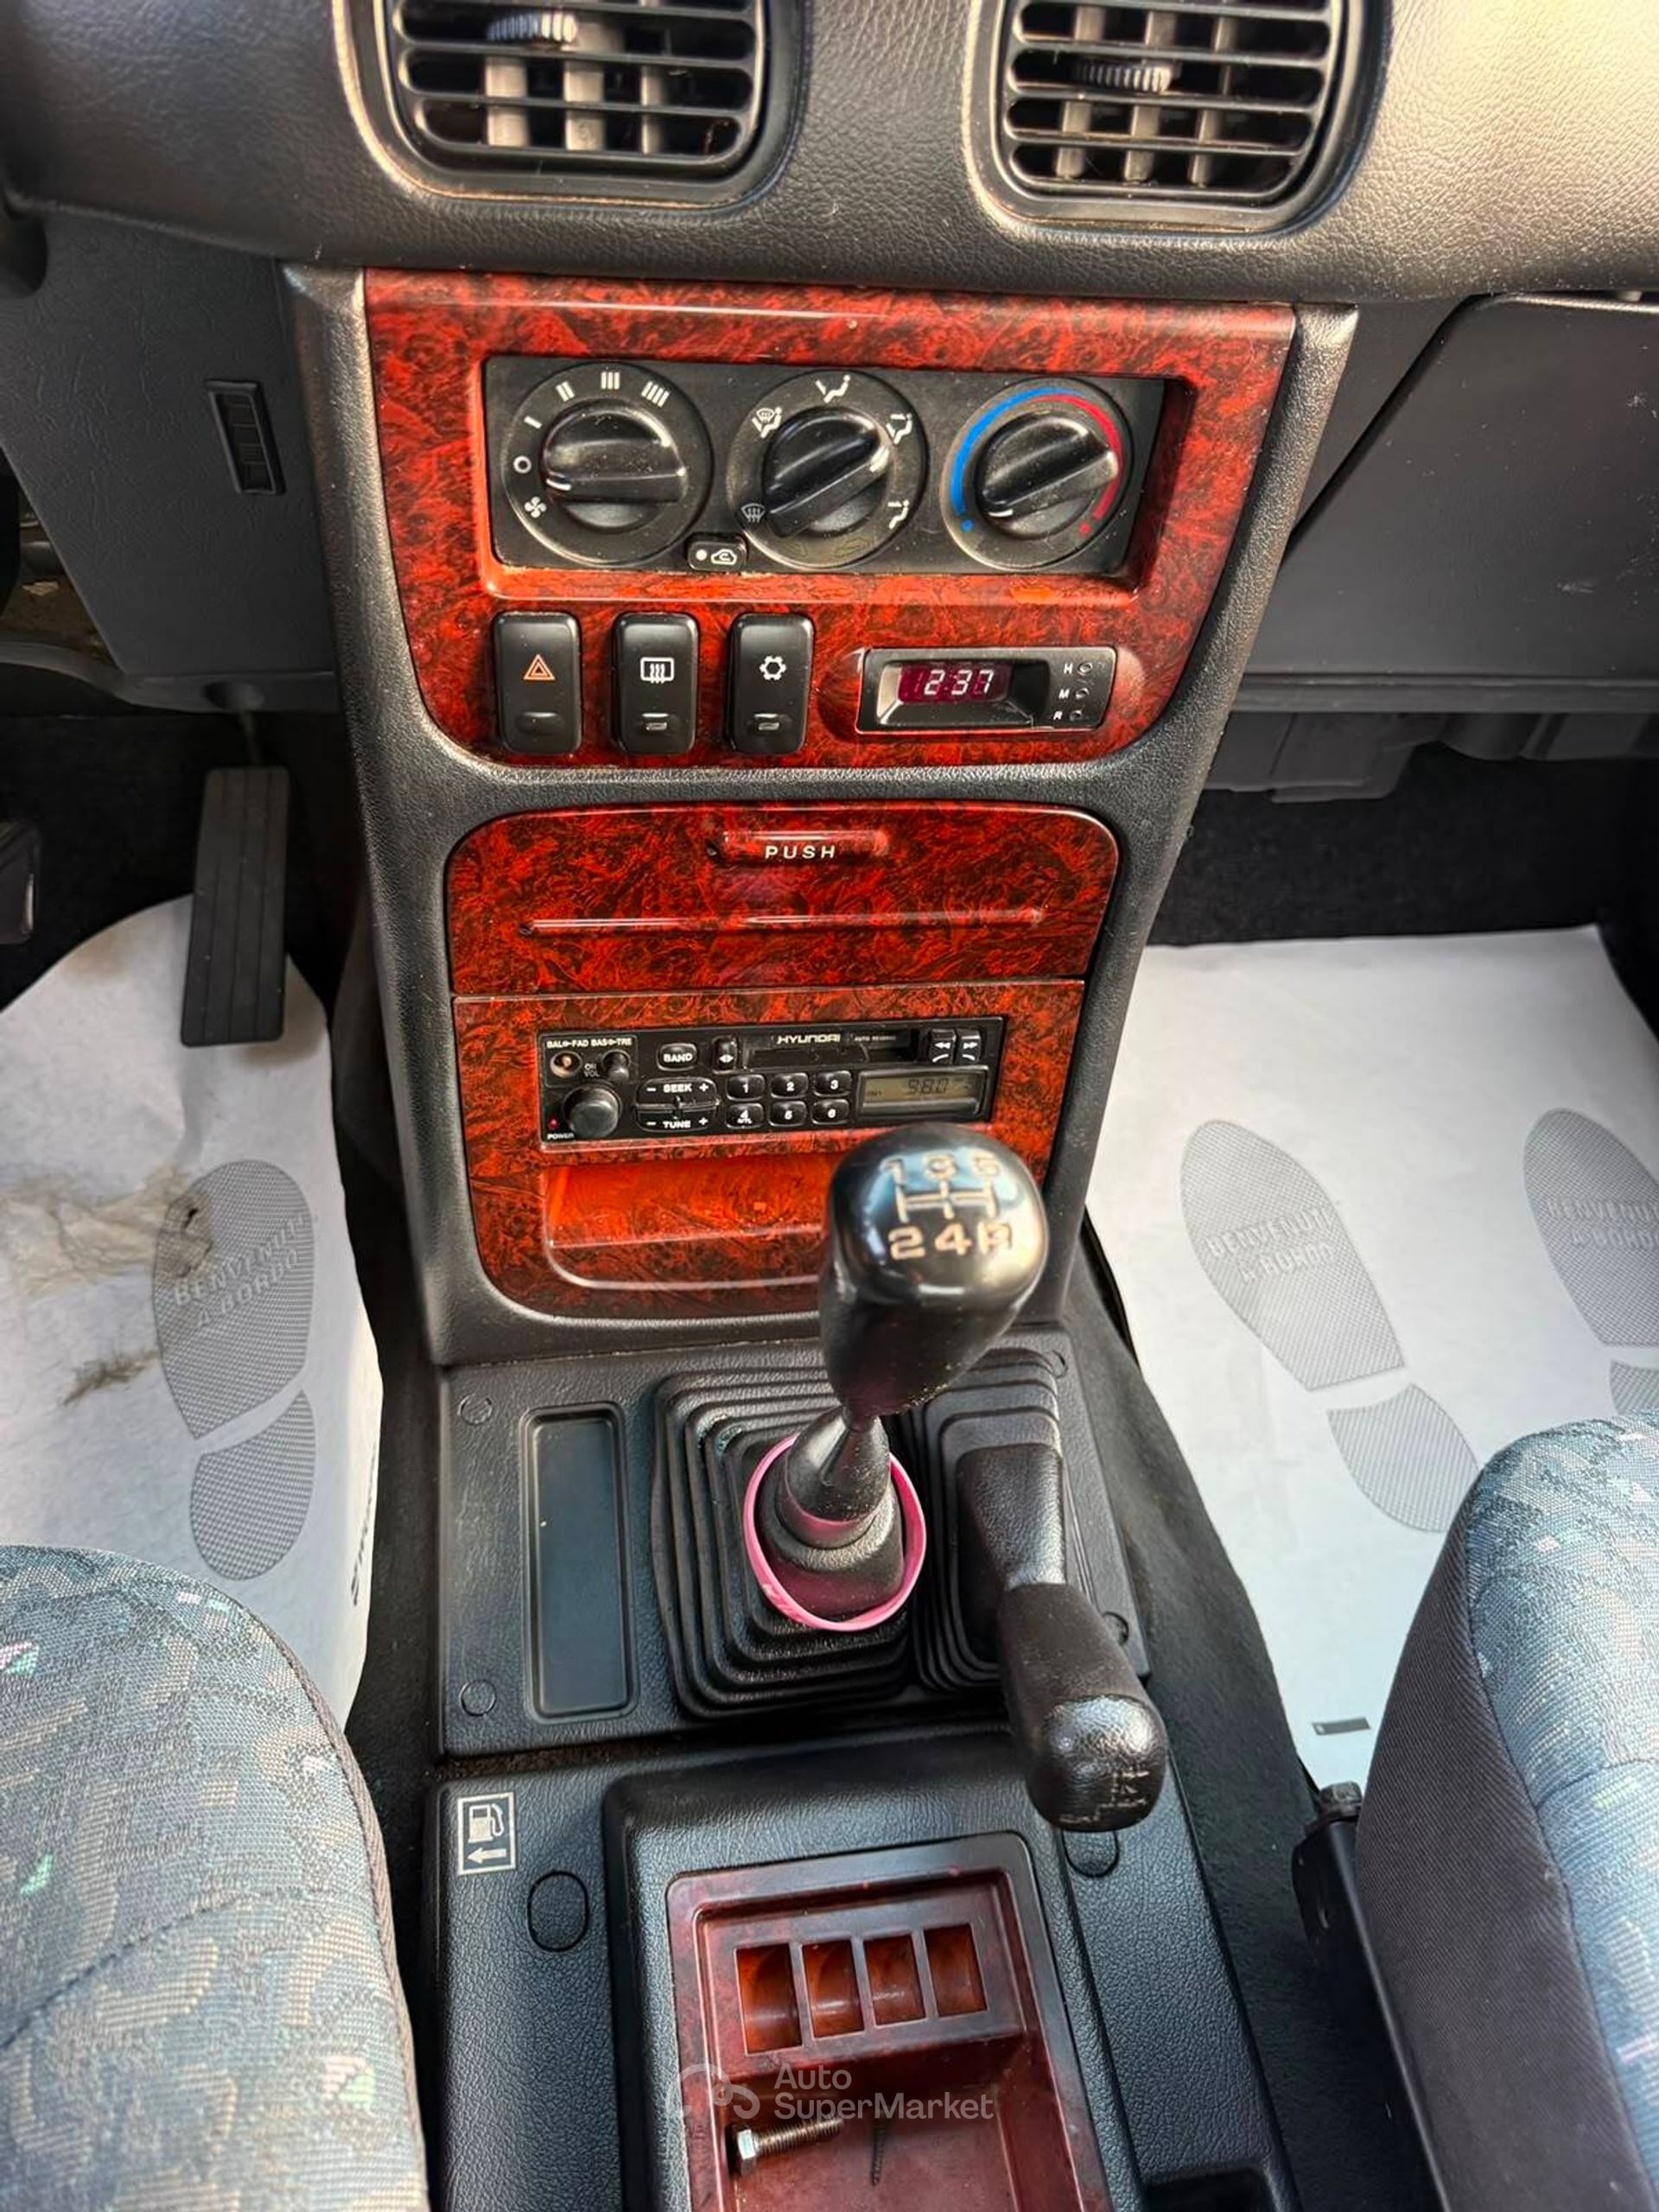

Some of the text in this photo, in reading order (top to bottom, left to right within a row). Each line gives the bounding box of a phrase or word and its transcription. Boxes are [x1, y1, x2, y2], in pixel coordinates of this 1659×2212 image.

[1058, 689, 1070, 699] M
[765, 845, 835, 859] PUSH
[777, 1033, 841, 1045] HYUNDAI
[663, 1052, 693, 1063] BAND
[663, 1084, 692, 1093] SEEK
[742, 1084, 750, 1093] 1
[786, 1082, 795, 1092] 2
[830, 1079, 838, 1090] 3
[740, 1109, 749, 1119] 4
[785, 1109, 792, 1120] 5
[828, 1109, 836, 1119] 6
[663, 1120, 691, 1128] TUNE
[887, 1224, 926, 1261] 2
[934, 1223, 973, 1255] 4
